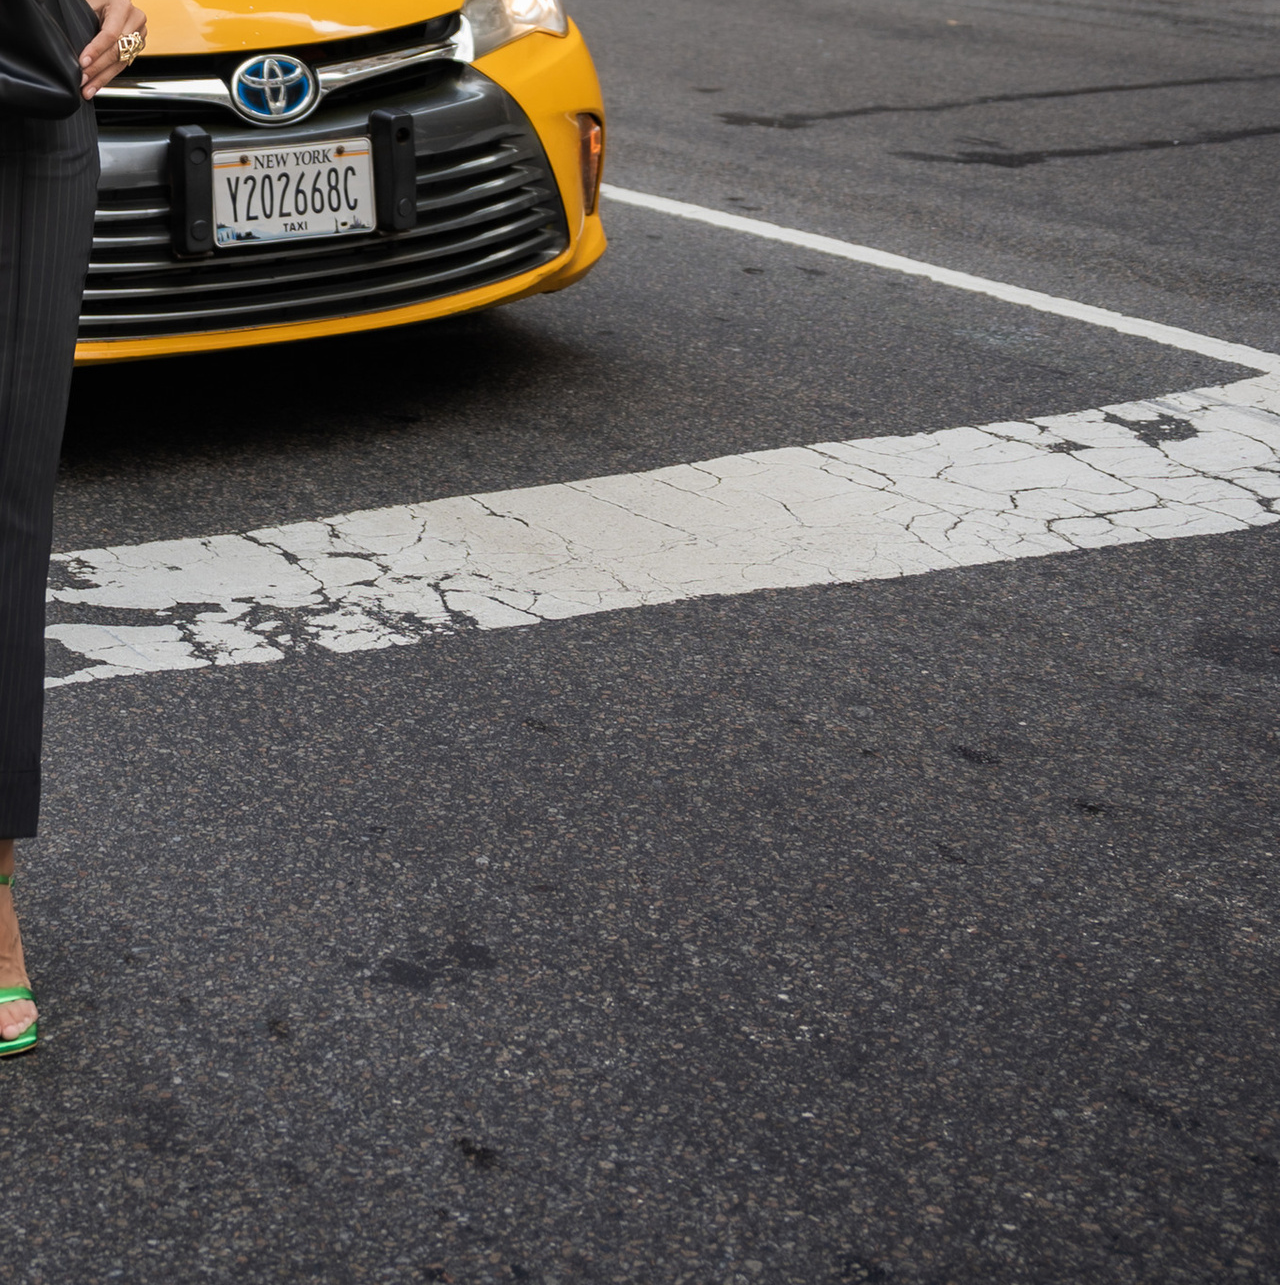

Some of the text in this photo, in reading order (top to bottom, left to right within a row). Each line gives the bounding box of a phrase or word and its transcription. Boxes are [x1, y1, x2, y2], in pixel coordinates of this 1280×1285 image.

[253, 148, 332, 170] NEW YORK
[226, 165, 358, 223] Y202668C
[283, 221, 308, 233] TAXI
